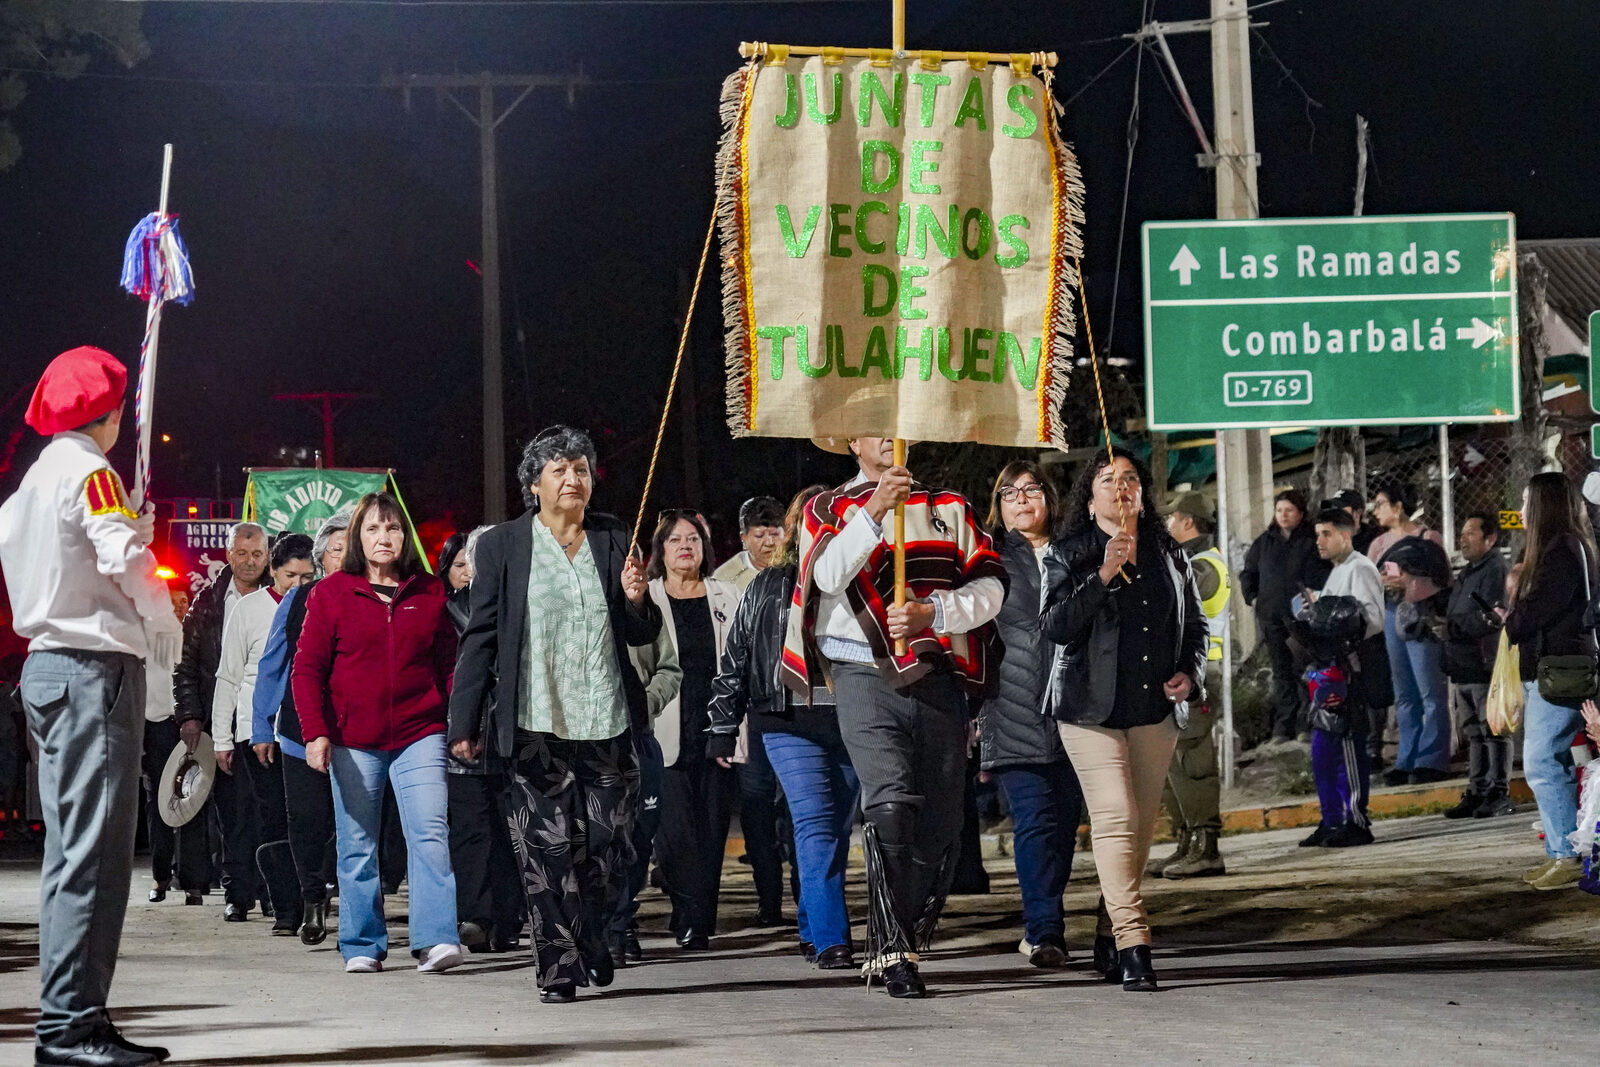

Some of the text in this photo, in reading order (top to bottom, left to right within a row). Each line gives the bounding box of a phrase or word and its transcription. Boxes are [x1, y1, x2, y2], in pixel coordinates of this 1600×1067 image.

[775, 72, 1037, 138] JUNTAS
[861, 139, 943, 194] DE
[775, 201, 1030, 269] VECINOS
[1219, 242, 1461, 279] Las Ramadas
[863, 264, 929, 320] DE
[757, 324, 1042, 391] TULAHUEN
[1222, 317, 1446, 356] Combarbalá
[1234, 378, 1302, 398] D-769
[285, 481, 343, 513] ADULTO
[1500, 513, 1523, 526] 50
